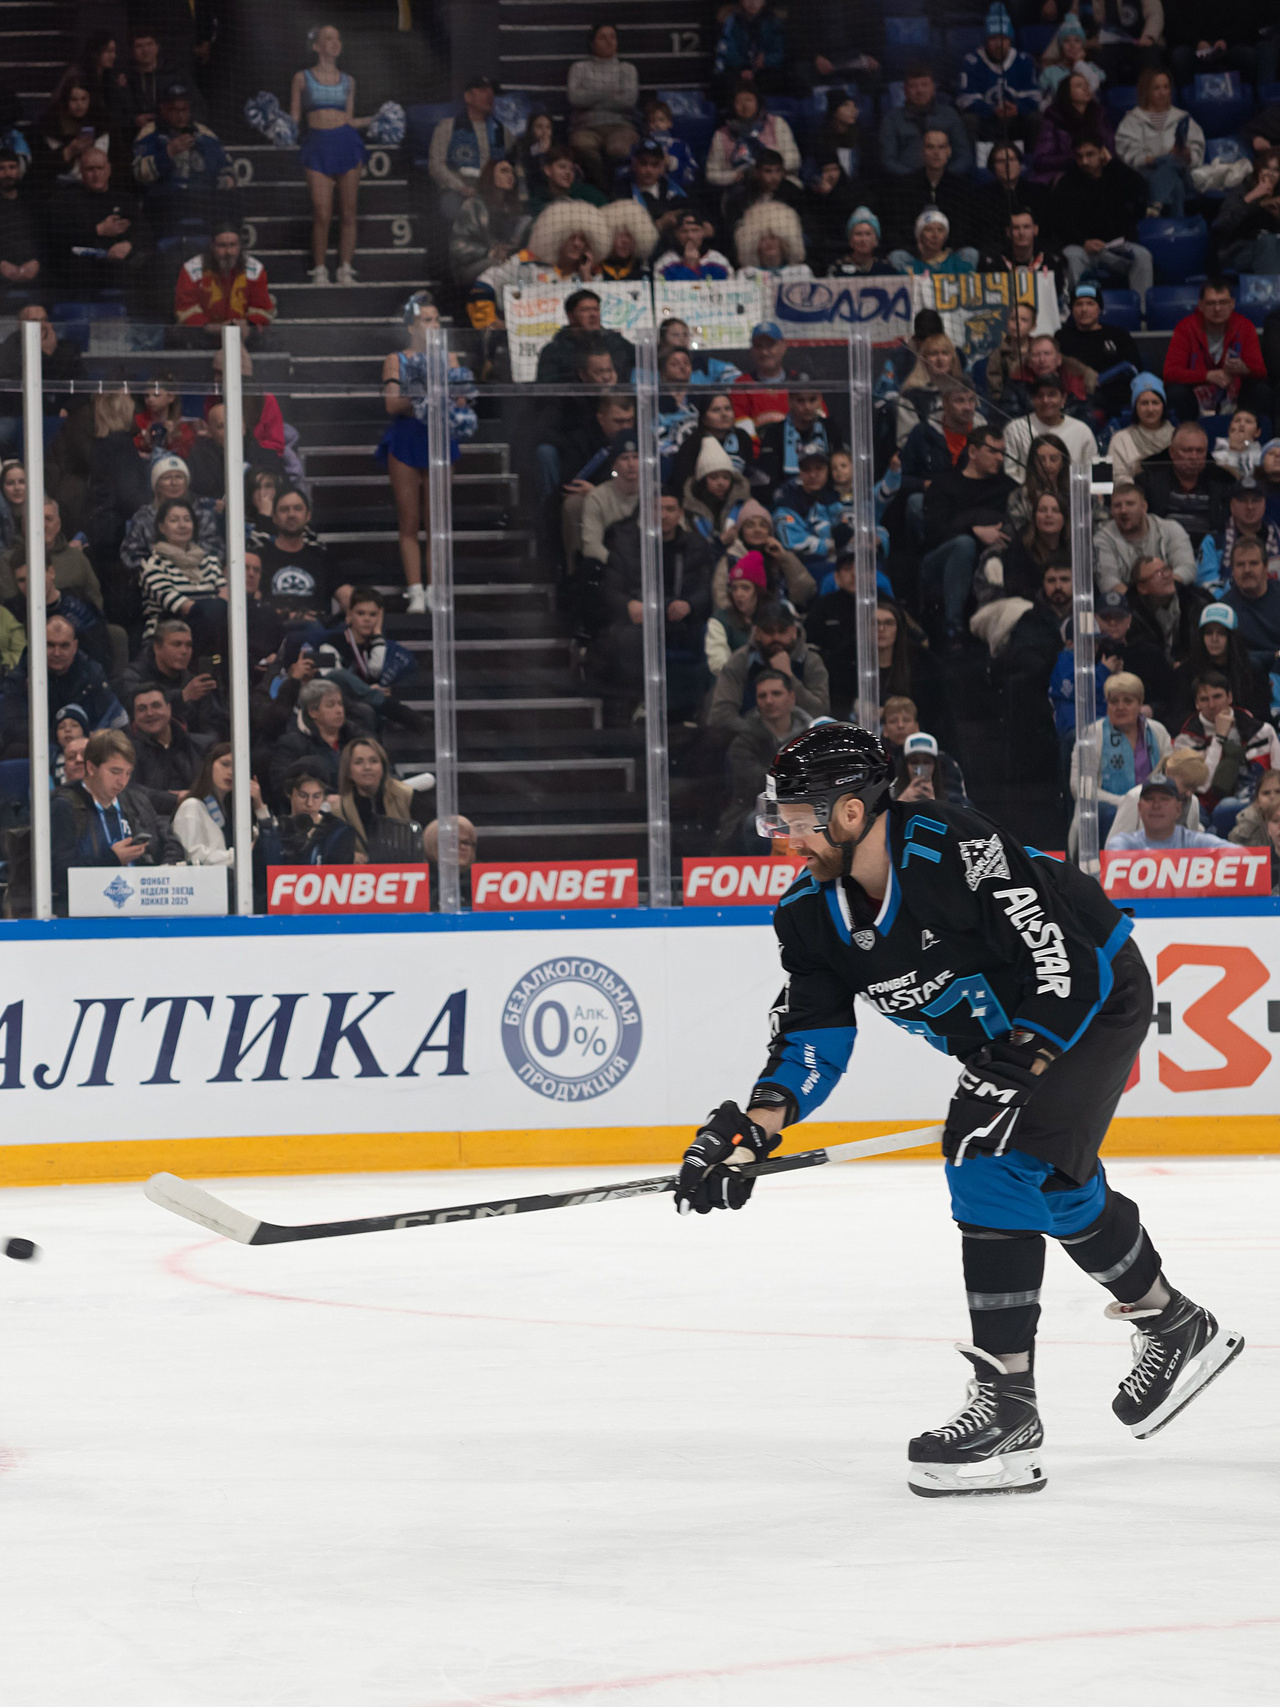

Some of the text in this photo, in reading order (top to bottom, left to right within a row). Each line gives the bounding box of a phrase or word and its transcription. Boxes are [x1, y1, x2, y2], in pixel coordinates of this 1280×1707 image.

[391, 217, 412, 245] 9
[835, 772, 864, 785] CCM
[900, 814, 949, 869] 77
[140, 877, 170, 886] ФОНБЕТ
[271, 872, 426, 906] FONBET
[475, 868, 634, 903] FONBET
[686, 865, 801, 898] FONB
[1104, 855, 1268, 890] FONBET
[140, 886, 169, 896] НЕДЕЛЯ
[171, 886, 195, 896] ЗВЕЗД
[140, 896, 188, 906] ХОККЕЯ 2025
[504, 960, 639, 1026] БЕЗАЛКОГОЛЬНАЯ
[867, 970, 918, 996] FONBET
[518, 1056, 629, 1102] ПРОДУКЦИЯ
[958, 1068, 1019, 1104] CM
[1164, 1348, 1181, 1380] CCM
